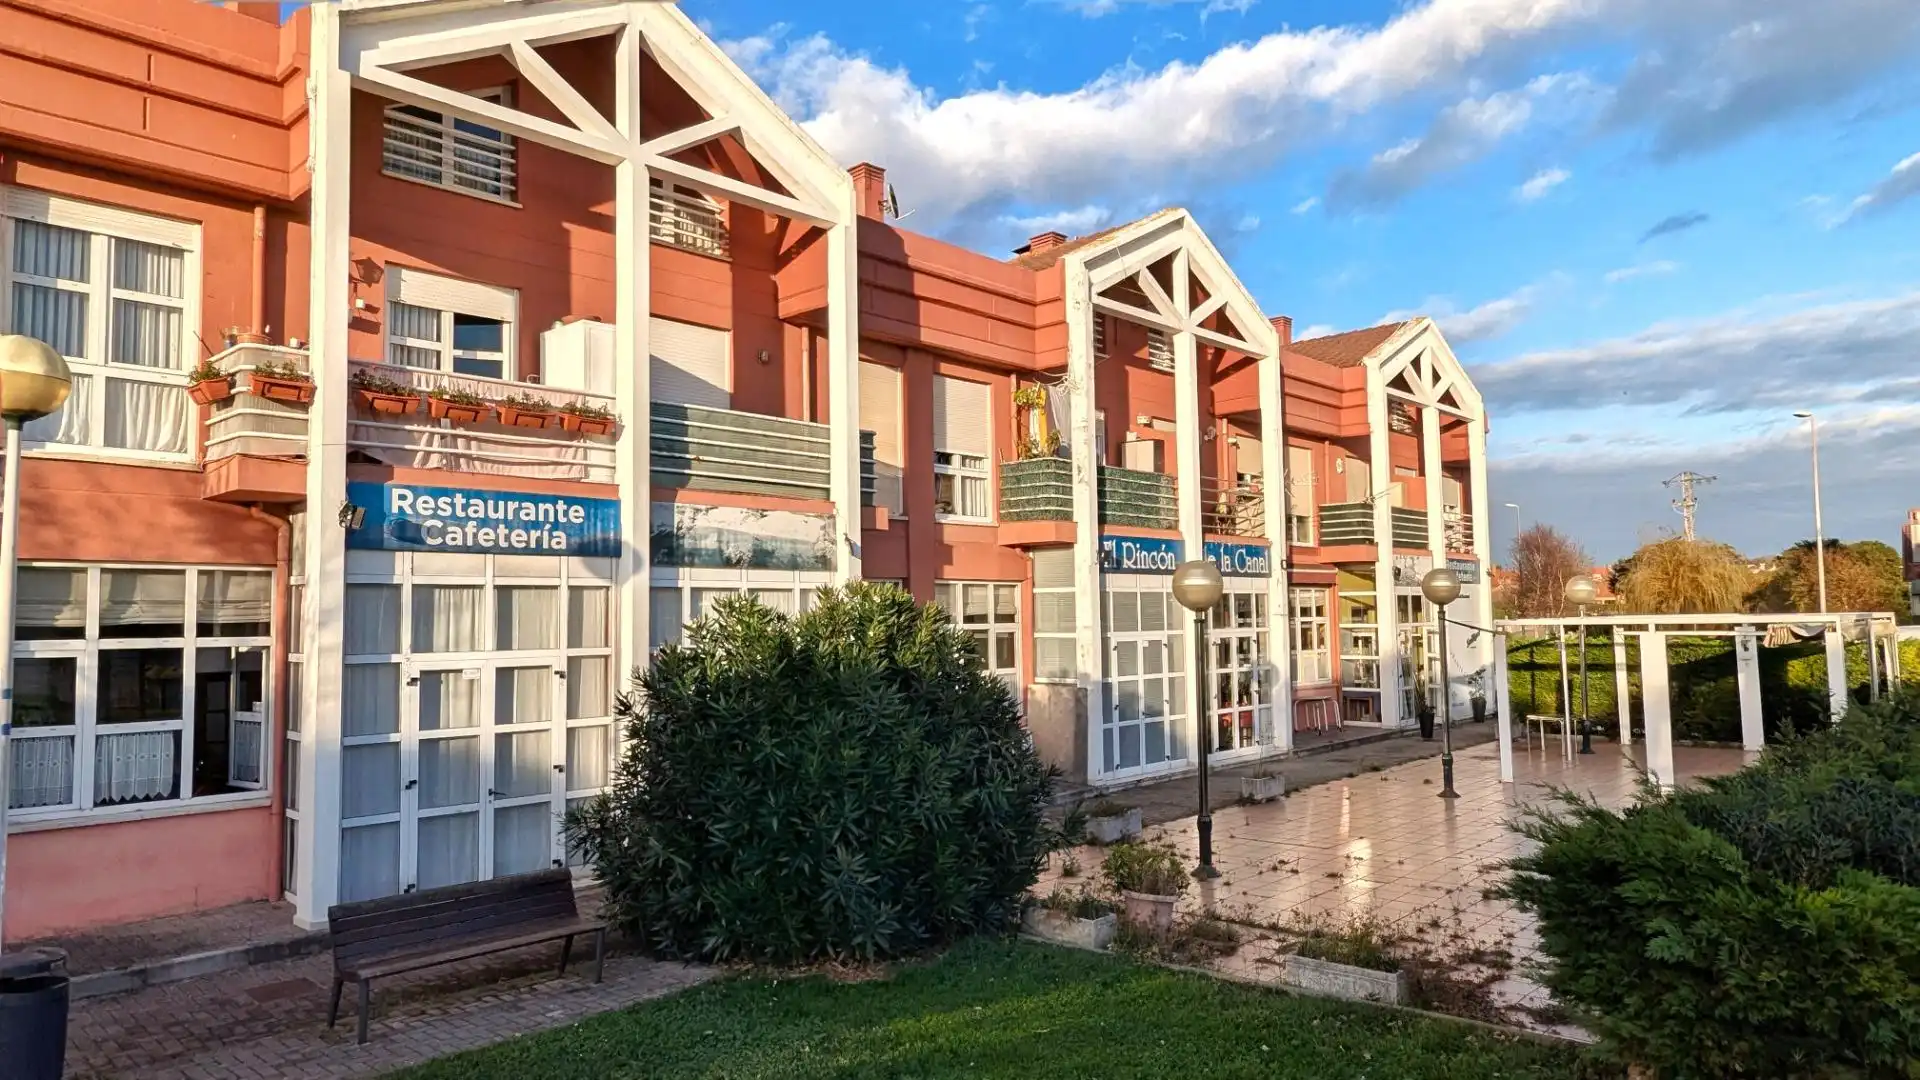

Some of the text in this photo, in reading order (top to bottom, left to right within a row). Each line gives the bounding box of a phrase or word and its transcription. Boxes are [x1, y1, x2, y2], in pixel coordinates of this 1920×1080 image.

[391, 488, 585, 524] Restaurante
[420, 519, 567, 550] Cafetería
[1121, 541, 1176, 570] Rincón
[1220, 546, 1232, 572] la
[1235, 548, 1269, 574] Canal
